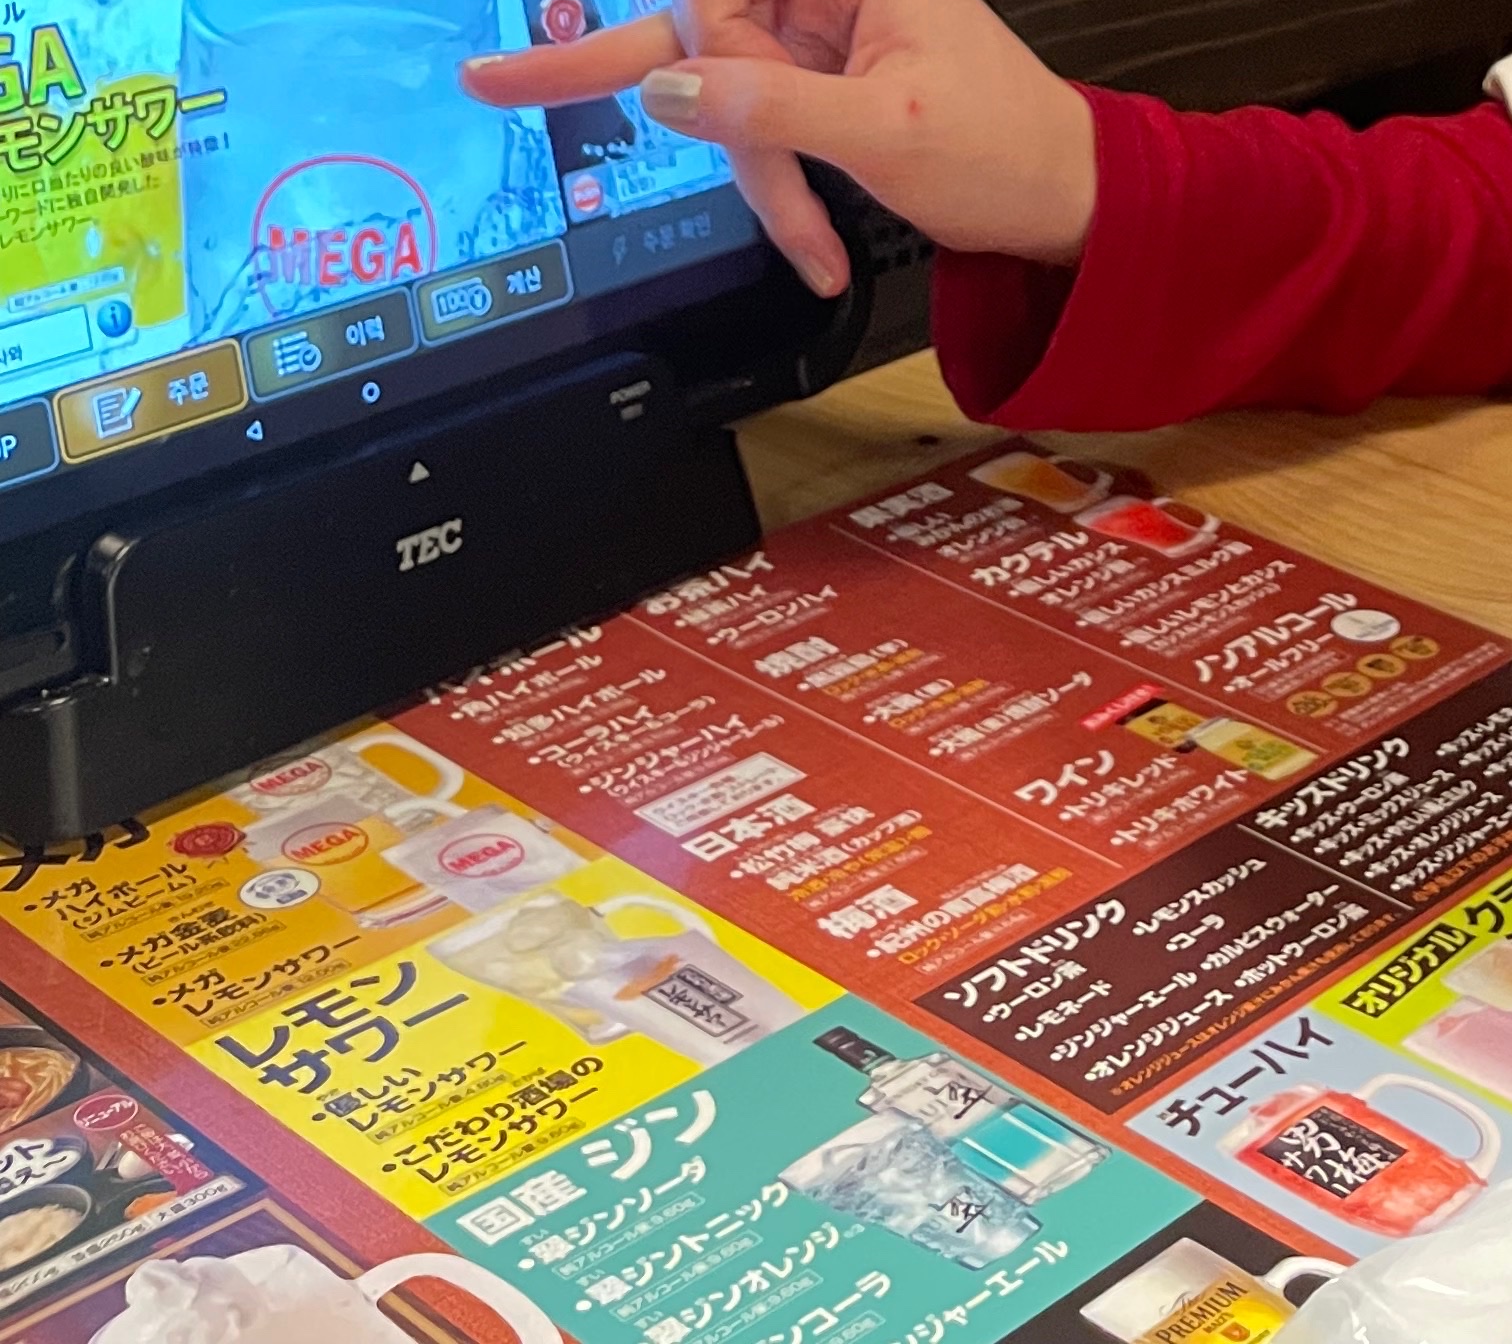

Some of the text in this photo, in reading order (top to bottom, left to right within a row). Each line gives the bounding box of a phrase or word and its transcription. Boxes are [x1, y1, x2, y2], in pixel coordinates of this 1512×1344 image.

[266, 221, 423, 289] MEGA
[397, 518, 463, 572] TEC
[970, 531, 1088, 586] カクテル
[715, 584, 837, 641] ウーロンハイ
[1194, 592, 1357, 682] ノンアルコール
[1229, 632, 1333, 689] オールフリー
[537, 704, 653, 761] コーラハイ
[588, 713, 744, 790] ジンジャーハイ
[252, 760, 323, 790] MEGA
[1013, 749, 1114, 805] ワイン
[1063, 756, 1176, 817] トリキレッド
[1114, 769, 1247, 843] トリキホワイト
[1255, 737, 1409, 828] キッズドリンク
[288, 827, 360, 857] MEGA
[448, 839, 513, 870] MEGA
[680, 793, 814, 862] 日本酒
[40, 876, 97, 908] メガ
[55, 862, 188, 921] ハイボール
[817, 884, 917, 939] 梅酒
[1135, 858, 1266, 933] レモンスカッシュ
[943, 899, 1125, 1007] ソフトドリンク
[1168, 913, 1225, 949] コーラ
[1239, 902, 1368, 984] ホットウーロン茶
[167, 967, 225, 1002] メガ
[181, 935, 360, 1017] レモンサワー
[987, 960, 1087, 1019] ウーロン茶
[1343, 923, 1474, 1016] オリジナル
[214, 961, 416, 1068] レモン
[1018, 979, 1111, 1038] レモネード
[1054, 971, 1197, 1058] ジンジャーエール
[1089, 988, 1233, 1078] オレンジジュース
[258, 993, 468, 1094] サワー
[1158, 1016, 1333, 1136] チューハイ
[323, 1067, 421, 1118] 優しい
[346, 1040, 527, 1132] レモンサワー
[394, 1056, 603, 1166] こだわり酒場の
[417, 1086, 597, 1183] レモンサワー
[457, 1089, 716, 1244] 国産 ジン
[1279, 1117, 1389, 1183] 男梅
[766, 1270, 891, 1344] ンコーラ
[1155, 1280, 1249, 1344] PREMIUM
